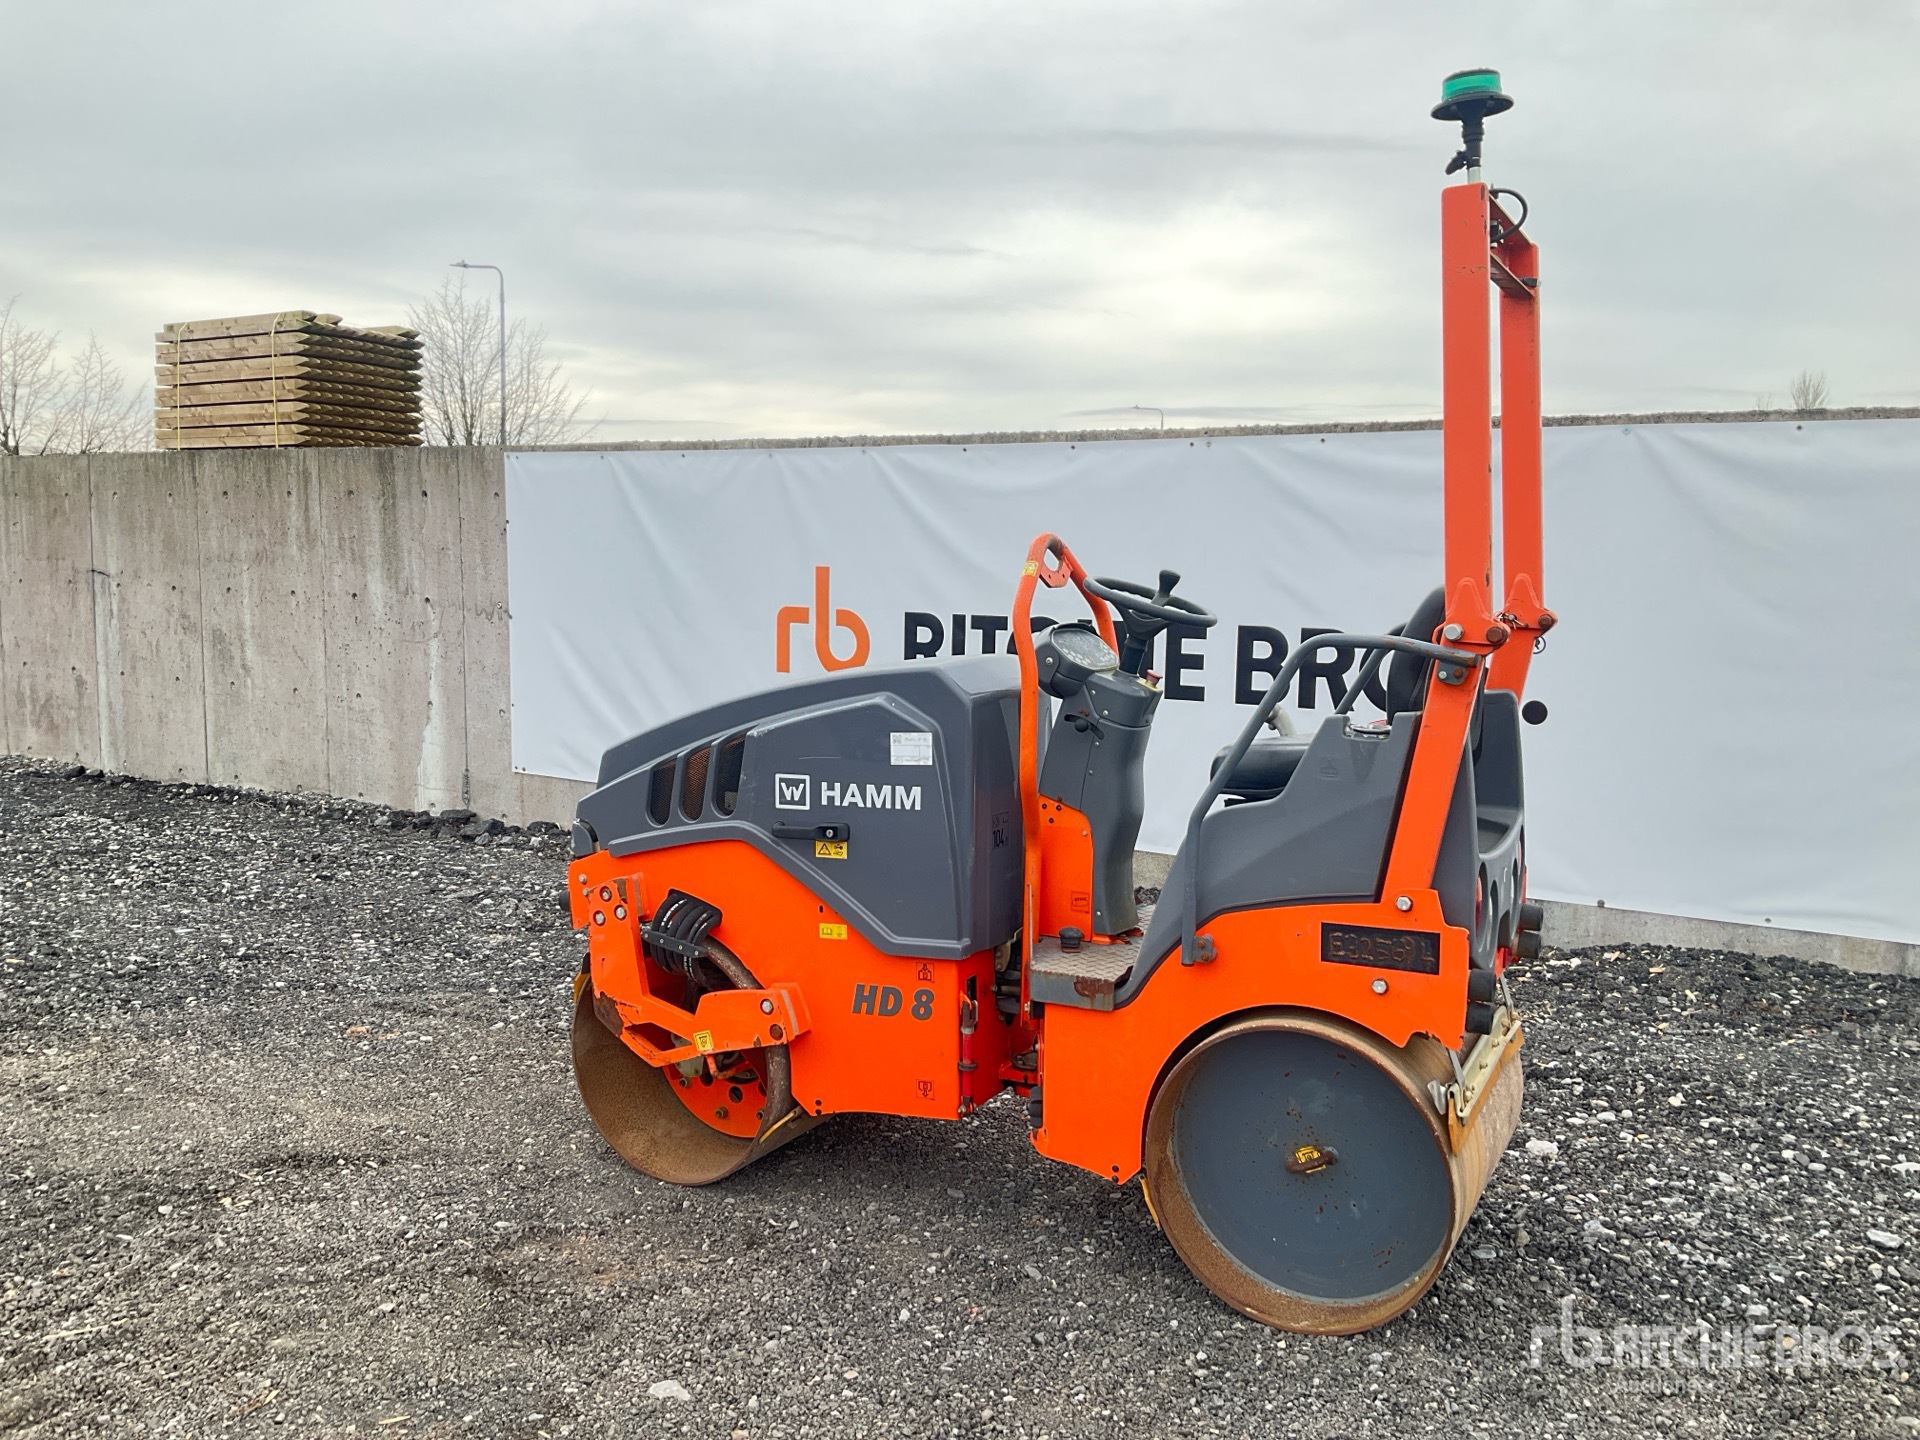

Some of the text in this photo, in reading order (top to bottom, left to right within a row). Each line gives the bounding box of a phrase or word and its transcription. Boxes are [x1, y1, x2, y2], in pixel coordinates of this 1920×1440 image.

[776, 566, 871, 673] rb
[821, 781, 922, 811] HAMM
[852, 983, 935, 1021] HD 8
